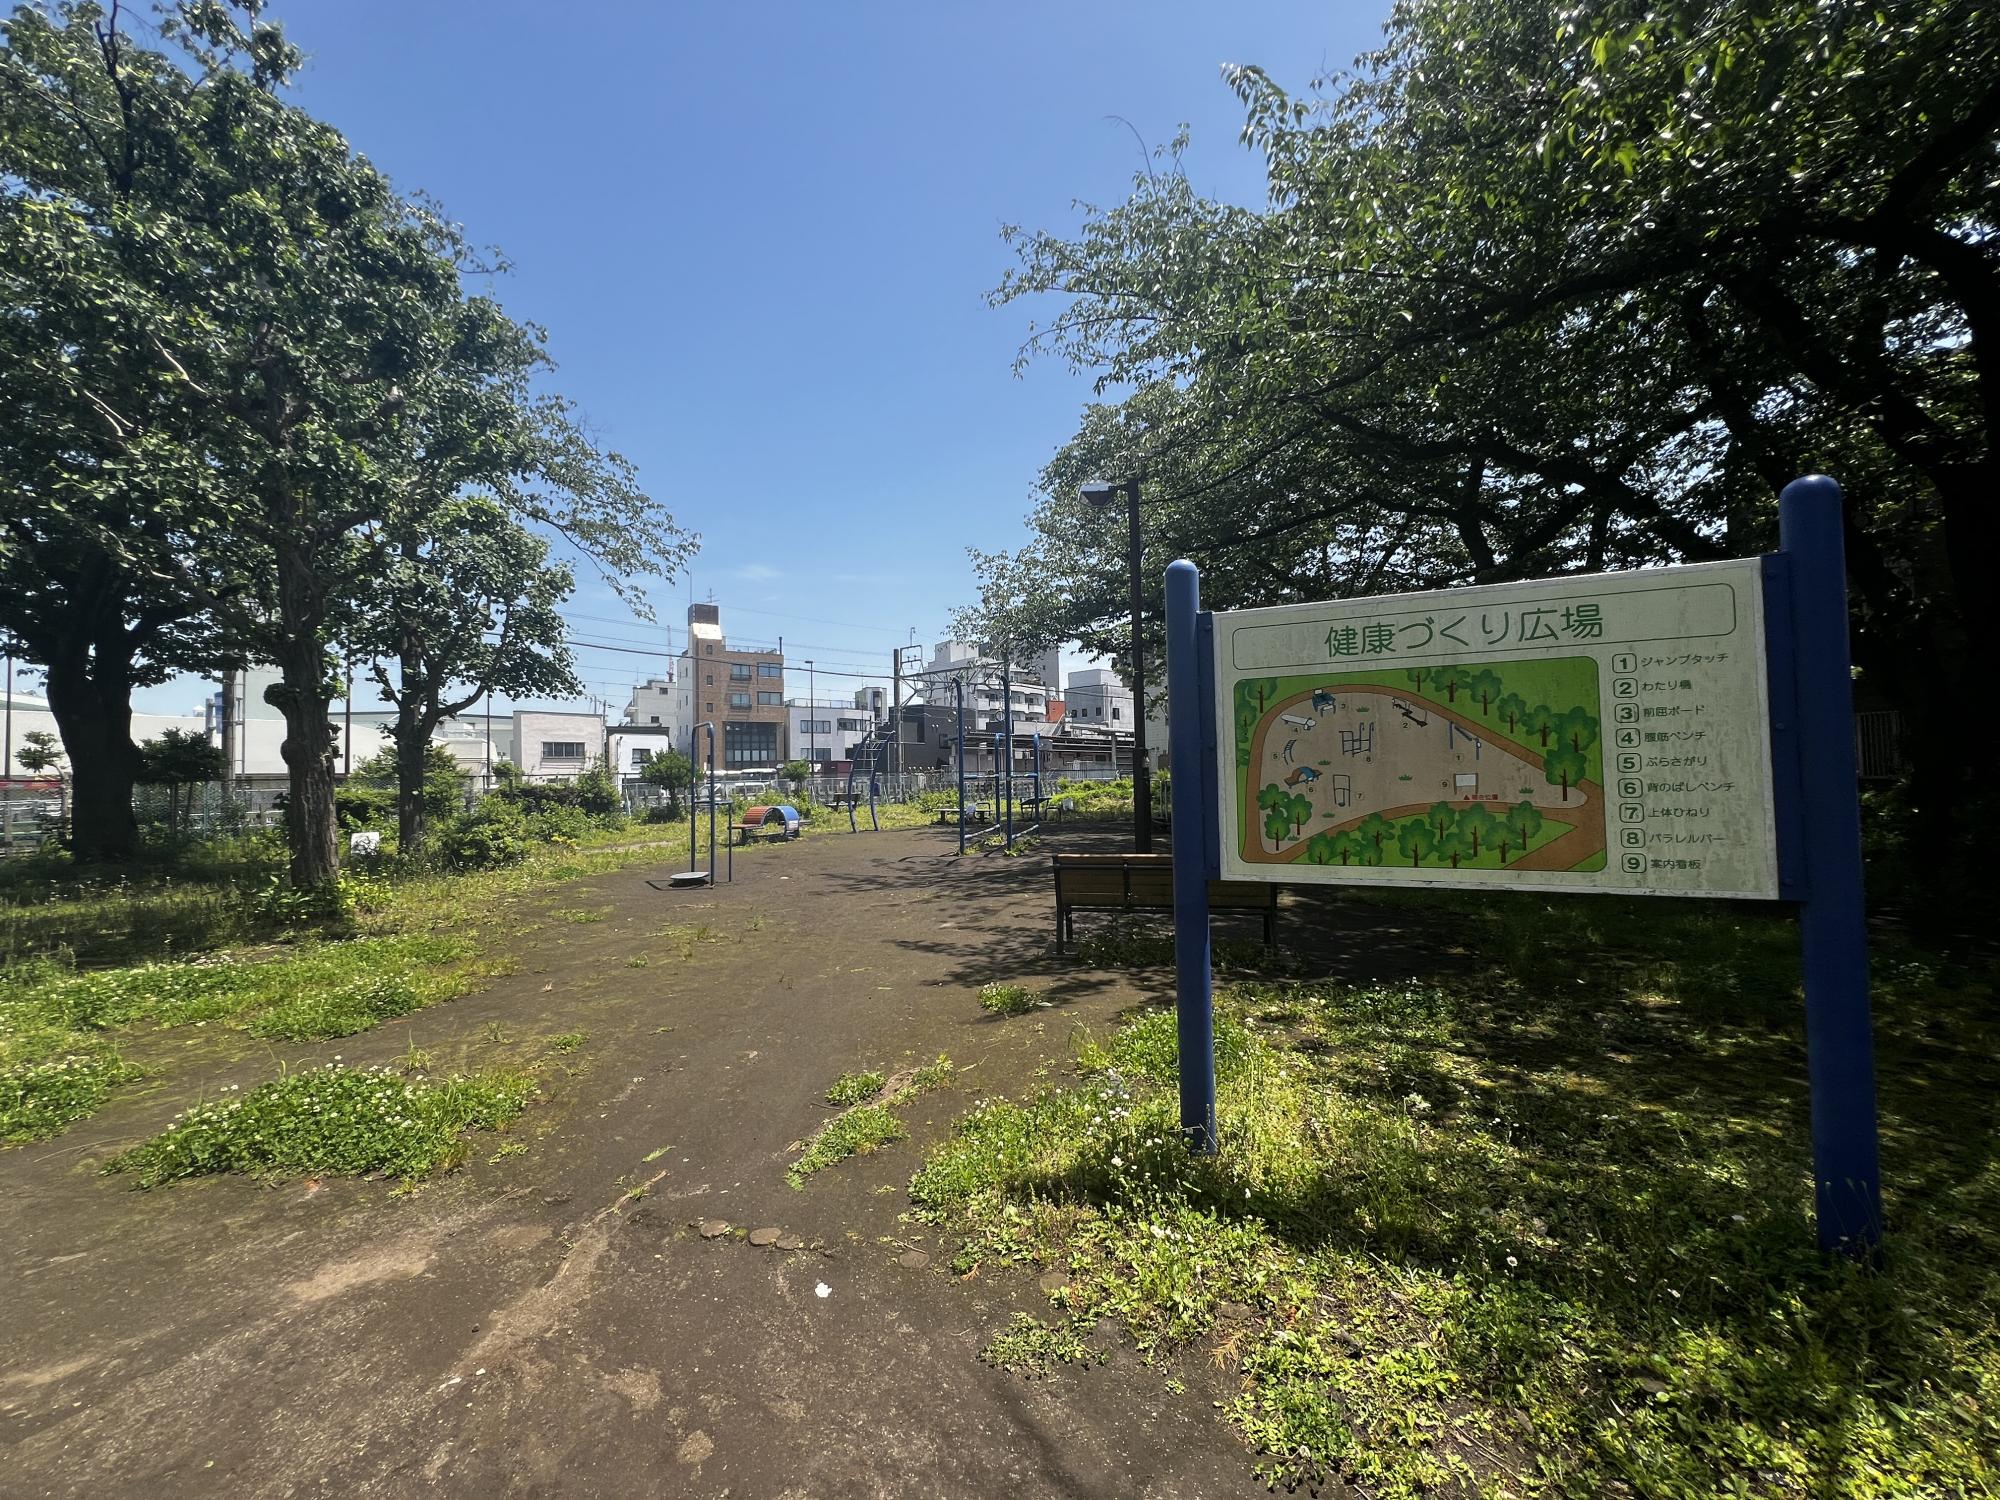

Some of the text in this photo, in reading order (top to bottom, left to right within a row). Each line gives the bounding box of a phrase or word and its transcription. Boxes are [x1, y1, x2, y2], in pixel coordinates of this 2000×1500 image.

[1325, 603, 1604, 658] 健康づくり広場
[1618, 681, 1632, 695] 2
[1619, 706, 1633, 720] 3
[1620, 730, 1707, 745] 4 腹筋ベンチ
[1623, 756, 1636, 770] 5
[1623, 781, 1636, 795] 6
[1624, 806, 1710, 820] 7 上体ひねり
[1625, 831, 1639, 845] 8
[1626, 856, 1702, 870] 9 案内看板
